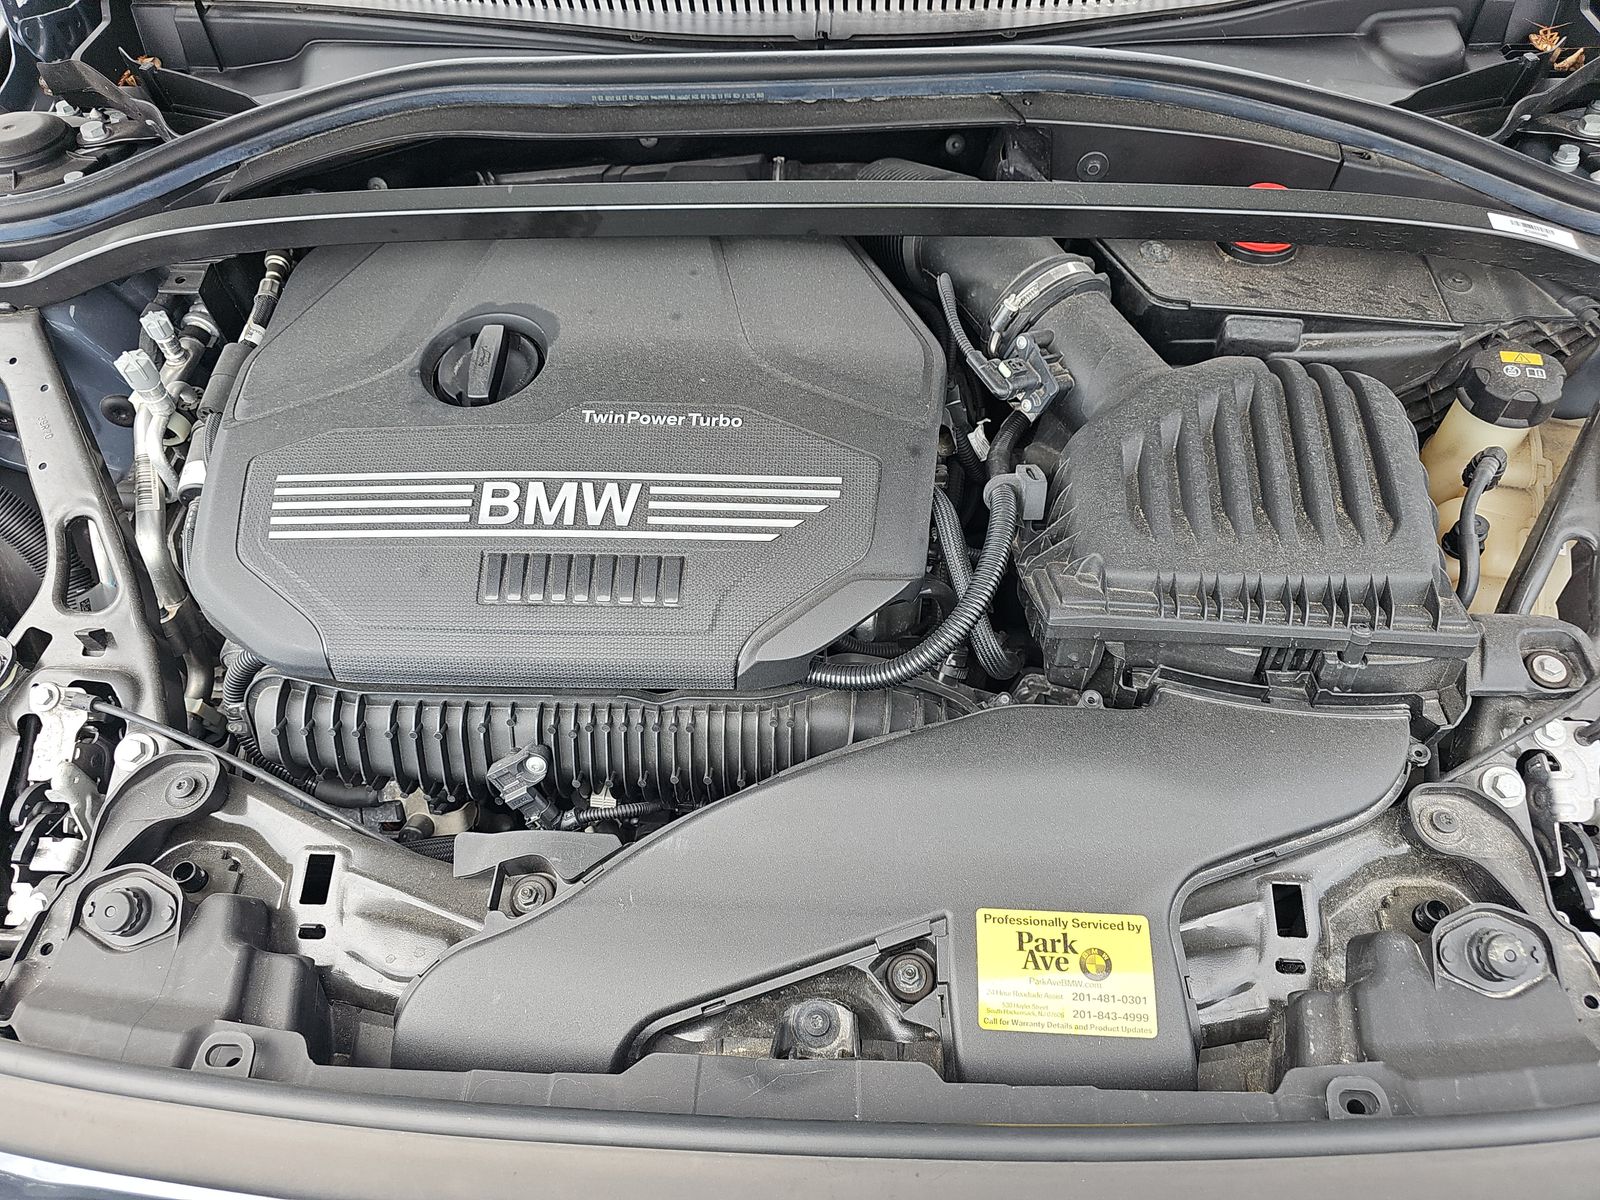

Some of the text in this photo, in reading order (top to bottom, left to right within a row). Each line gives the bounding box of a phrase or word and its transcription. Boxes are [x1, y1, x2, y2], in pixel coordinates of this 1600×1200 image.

[687, 412, 743, 428] Turbo
[477, 481, 643, 527] BMW
[983, 913, 1142, 934] Professionally Serviced by
[1015, 930, 1079, 955] Park
[1021, 949, 1070, 972] Ave
[1072, 991, 1147, 1005] 201-481-0301
[1072, 1009, 1149, 1023] 201-843-4999
[983, 1017, 1153, 1035] Call for Warranty Details and Product Updates
